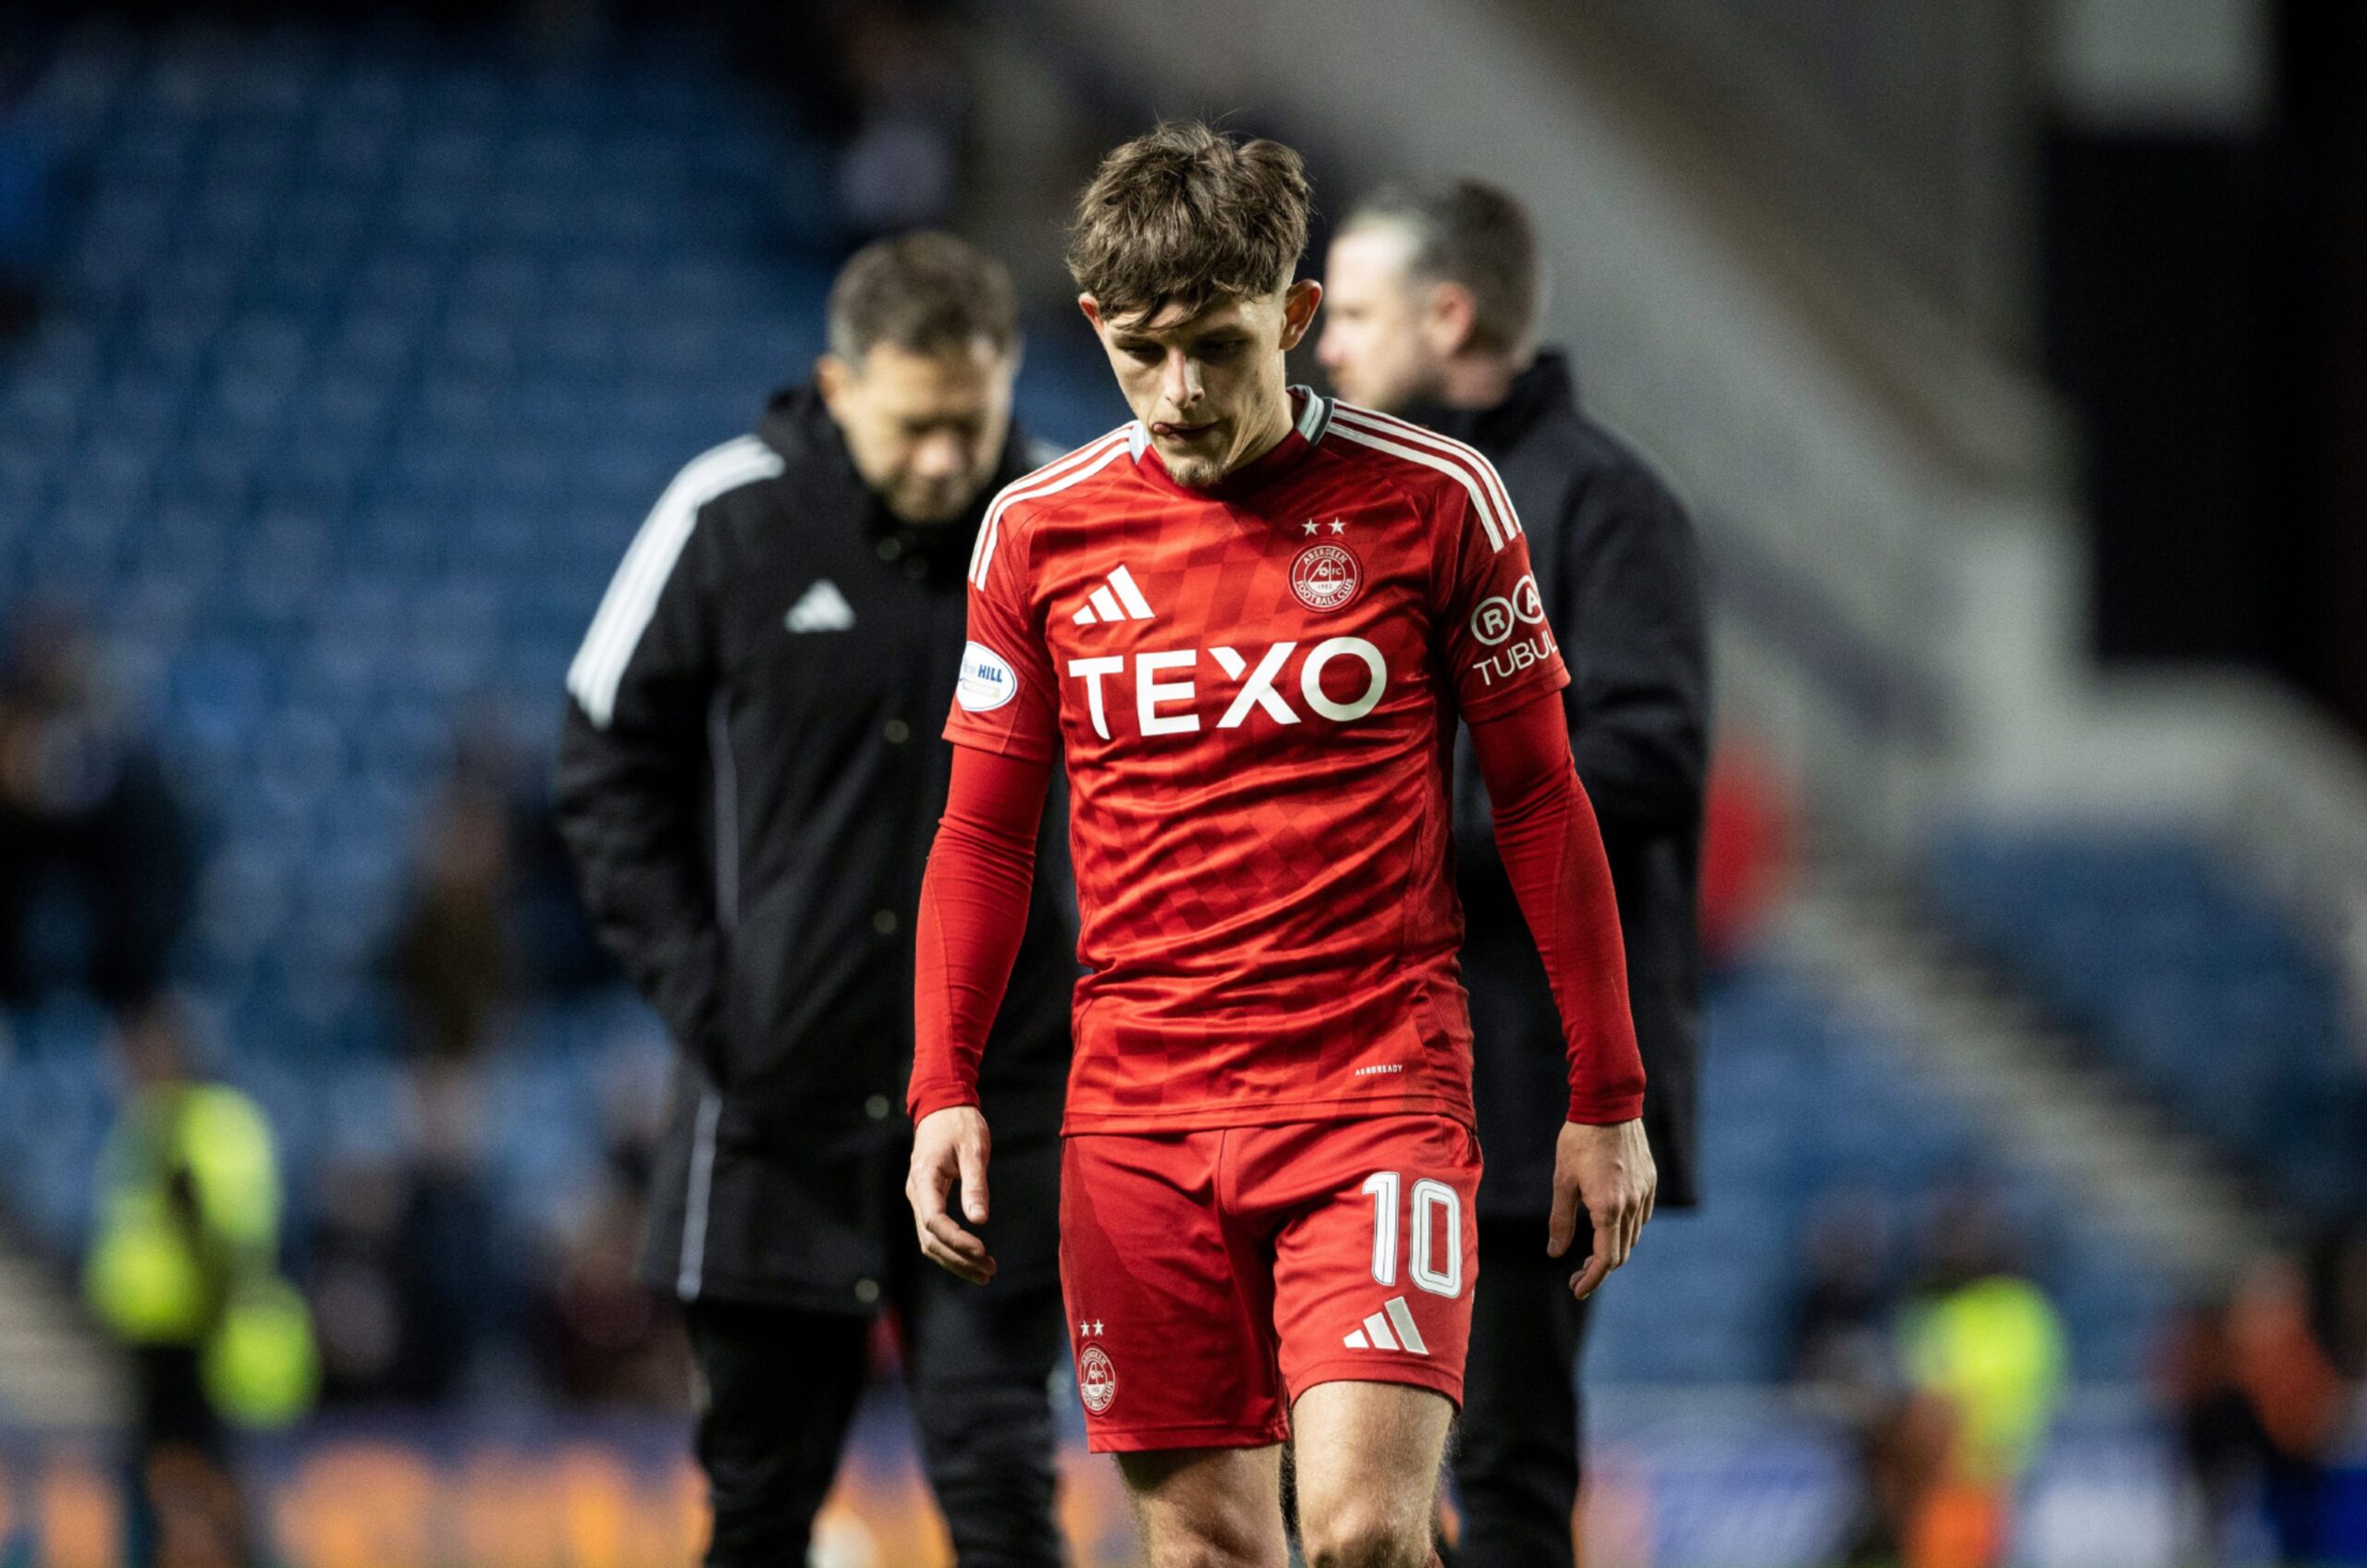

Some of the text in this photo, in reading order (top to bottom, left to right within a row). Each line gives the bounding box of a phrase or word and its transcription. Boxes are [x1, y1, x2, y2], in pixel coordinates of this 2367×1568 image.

[1303, 547, 1348, 565] ABERDEEN
[1296, 578, 1355, 606] FOOTBALL CLUB
[977, 664, 1003, 683] HILL
[1472, 630, 1558, 686] TUBUL
[1068, 636, 1387, 740] TEXO
[1361, 1170, 1463, 1299] 10
